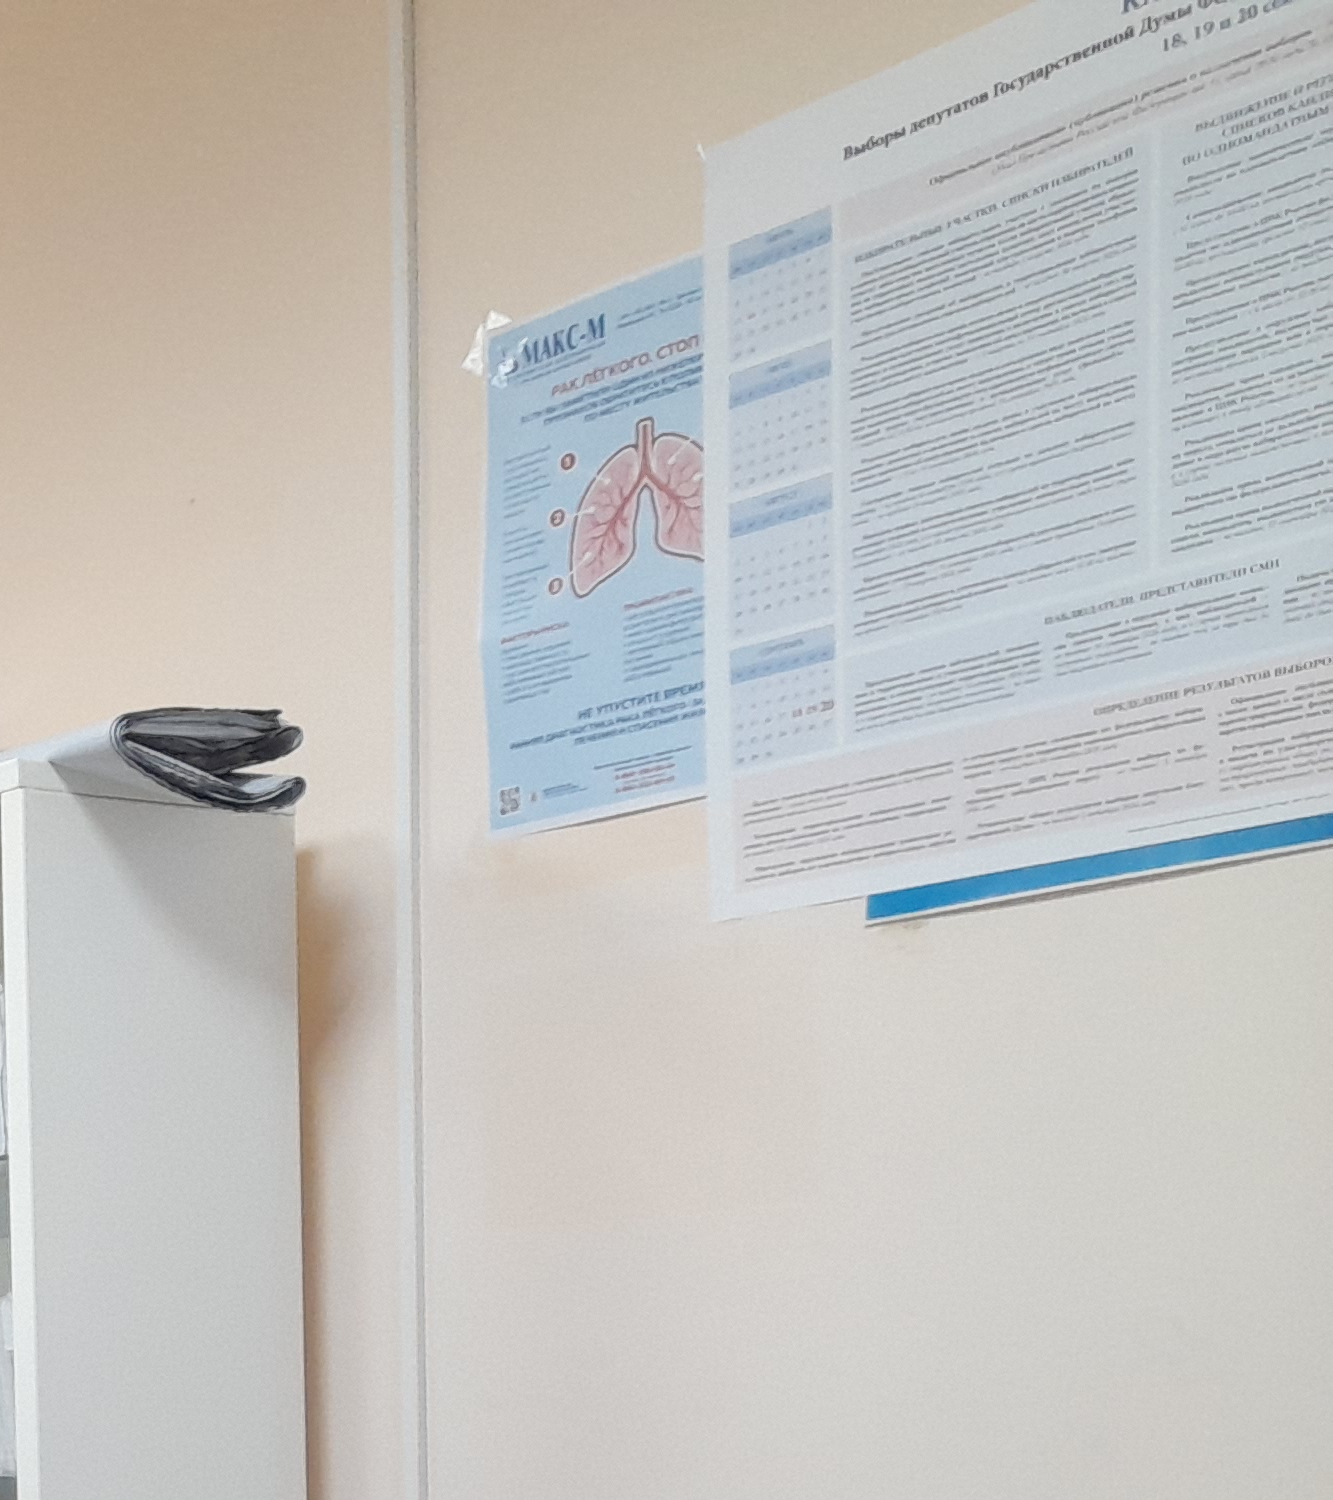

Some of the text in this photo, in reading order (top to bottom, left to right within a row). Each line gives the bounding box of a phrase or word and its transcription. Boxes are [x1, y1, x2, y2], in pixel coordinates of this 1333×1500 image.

[1138, 4, 1193, 38] Думы
[1194, 20, 1216, 40] 19
[522, 313, 606, 365] МАКС-М
[1273, 655, 1333, 679] ВЫБОРО
